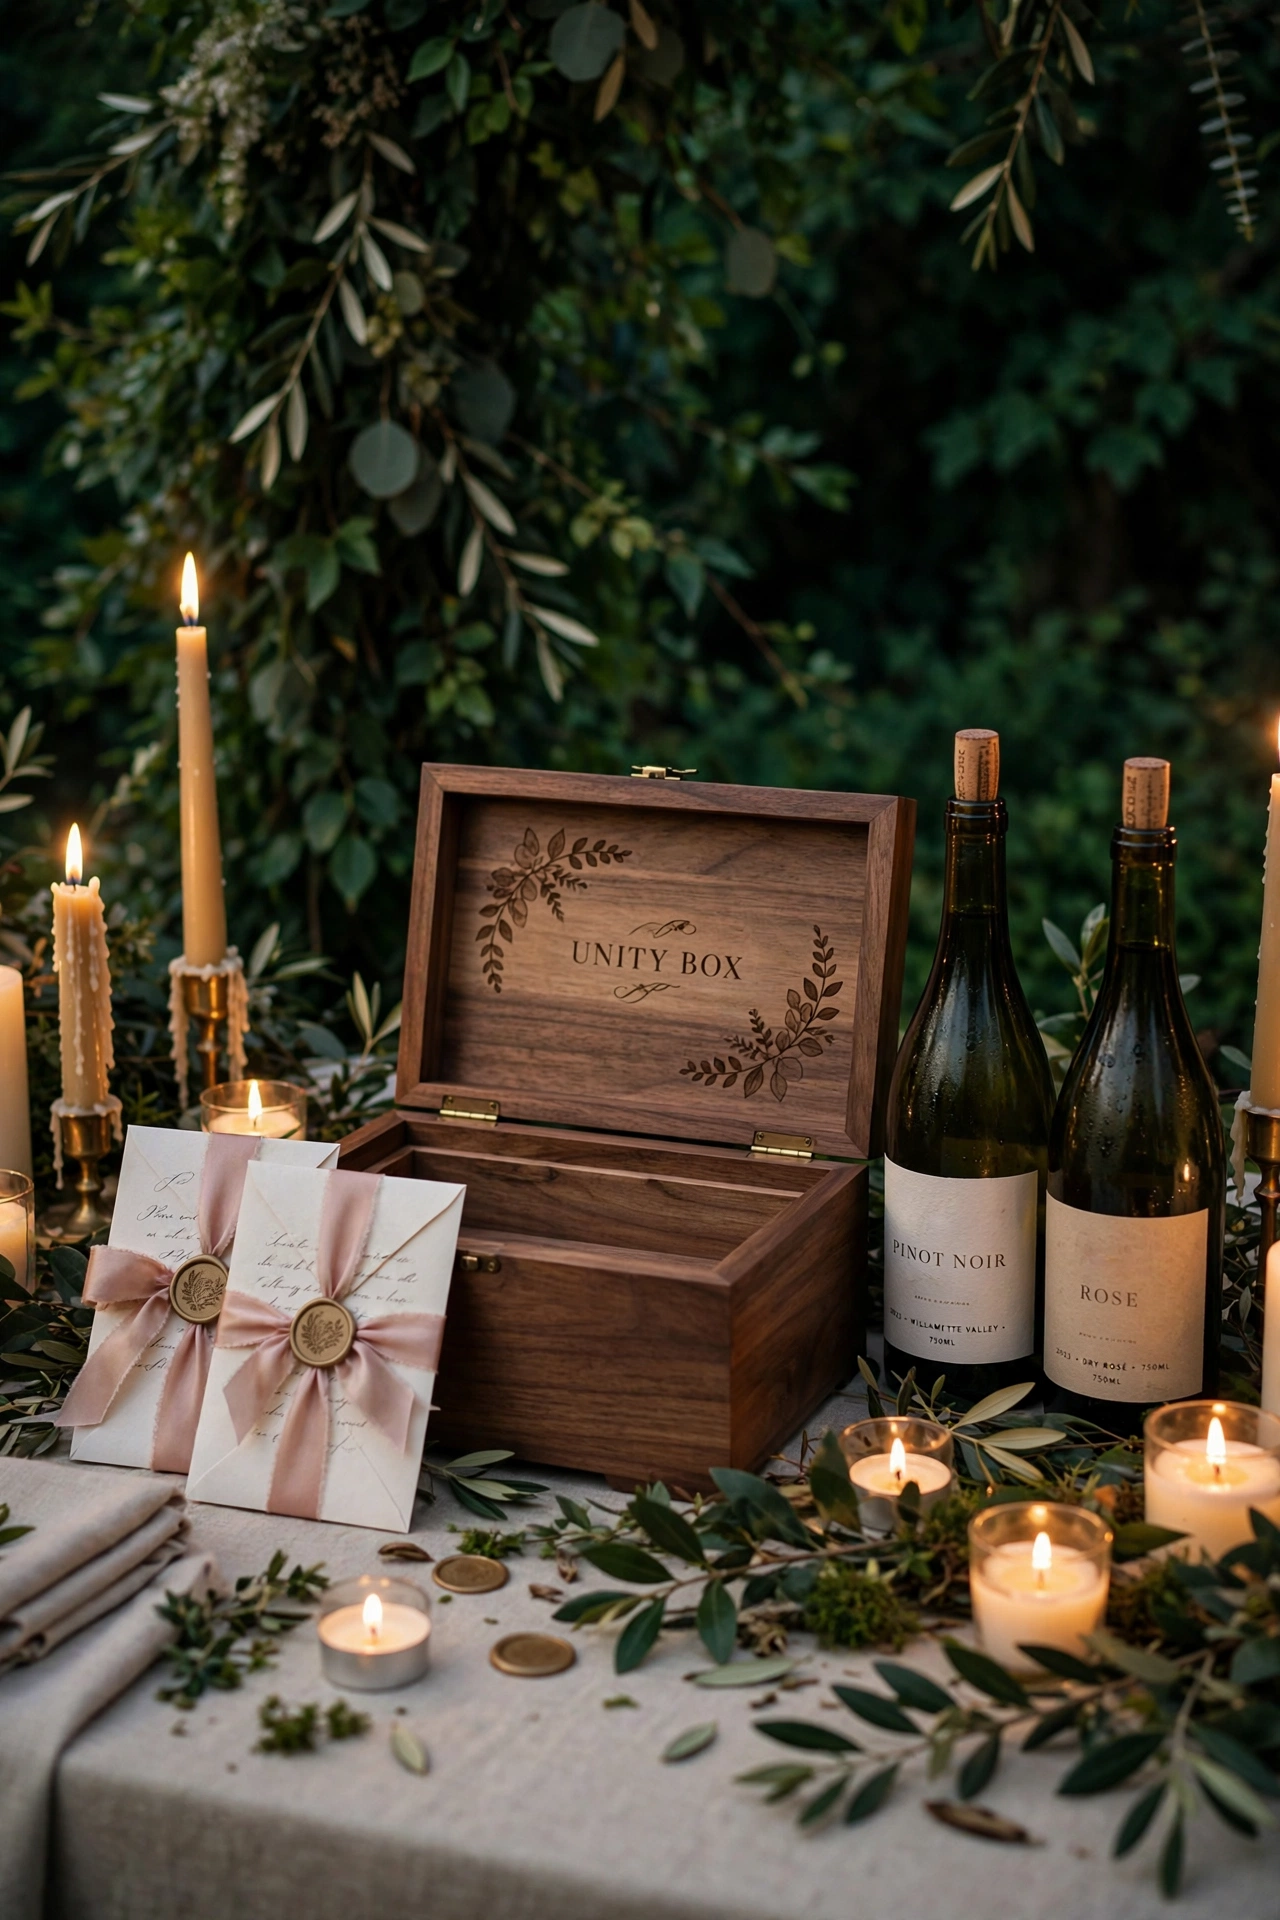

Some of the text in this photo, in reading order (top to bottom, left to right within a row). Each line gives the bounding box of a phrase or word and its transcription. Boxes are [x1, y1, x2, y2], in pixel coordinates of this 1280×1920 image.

[572, 940, 743, 980] UNITY BOX
[893, 1239, 1006, 1270] PINOT NOIR
[1080, 1284, 1138, 1308] ROSE
[966, 1325, 999, 1333] VALLEY
[929, 1336, 955, 1346] 750ML
[1082, 1358, 1099, 1368] DRY
[1141, 1363, 1170, 1371] 750ML
[1093, 1374, 1121, 1385] 750ML
